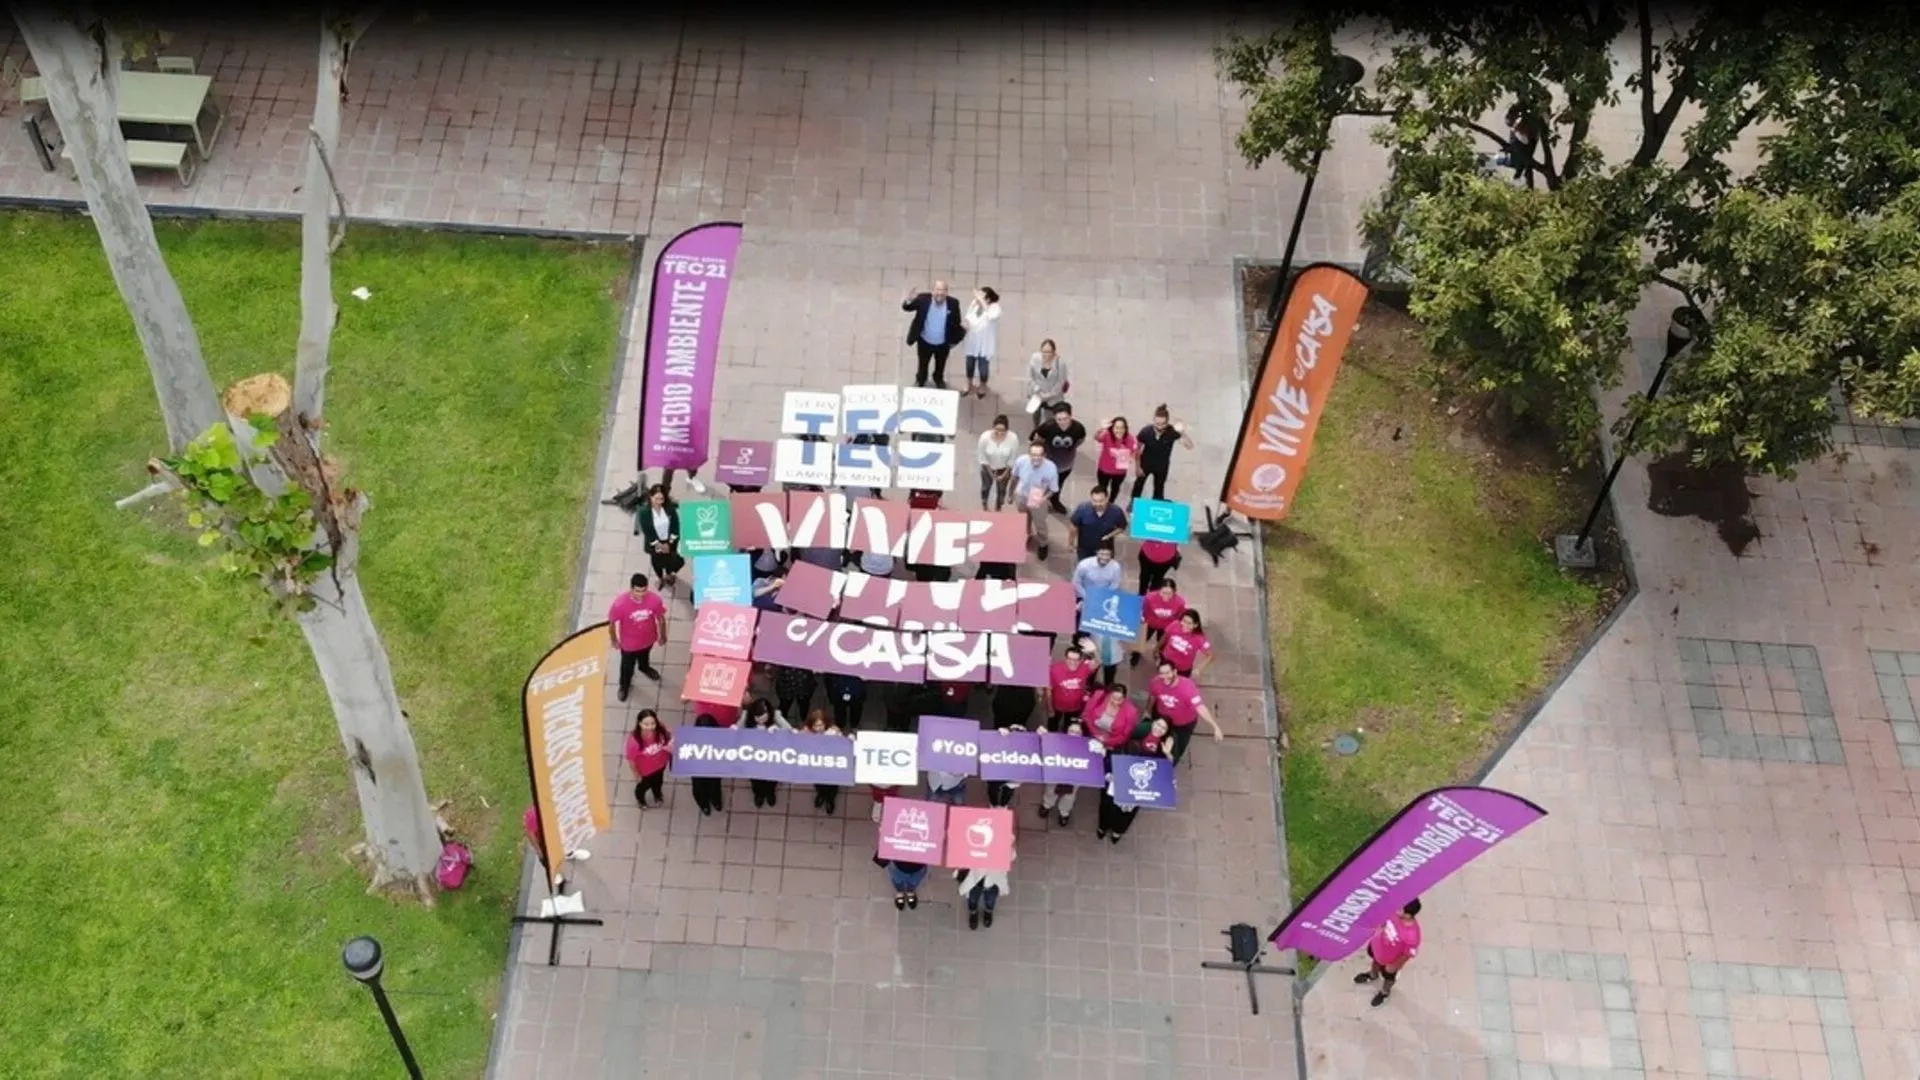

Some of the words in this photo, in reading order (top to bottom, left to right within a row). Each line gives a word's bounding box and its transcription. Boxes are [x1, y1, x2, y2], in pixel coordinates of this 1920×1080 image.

[664, 279, 707, 378] AMBIENTE
[1258, 375, 1309, 457] VIVE
[1295, 294, 1337, 370] CAUSA
[660, 383, 693, 444] MEDIO
[795, 409, 943, 468] TEC
[755, 494, 993, 566] VIVE
[829, 624, 1014, 679] CAUSA
[542, 685, 585, 767] SOCIAL
[679, 743, 848, 768] #ViveConCausa
[863, 748, 912, 766] TEC
[550, 756, 596, 853] SERVICIO
[1361, 877, 1389, 892] Y
[1371, 822, 1466, 886] TECNOLOGÍA
[1322, 887, 1382, 933] CIENCIA
